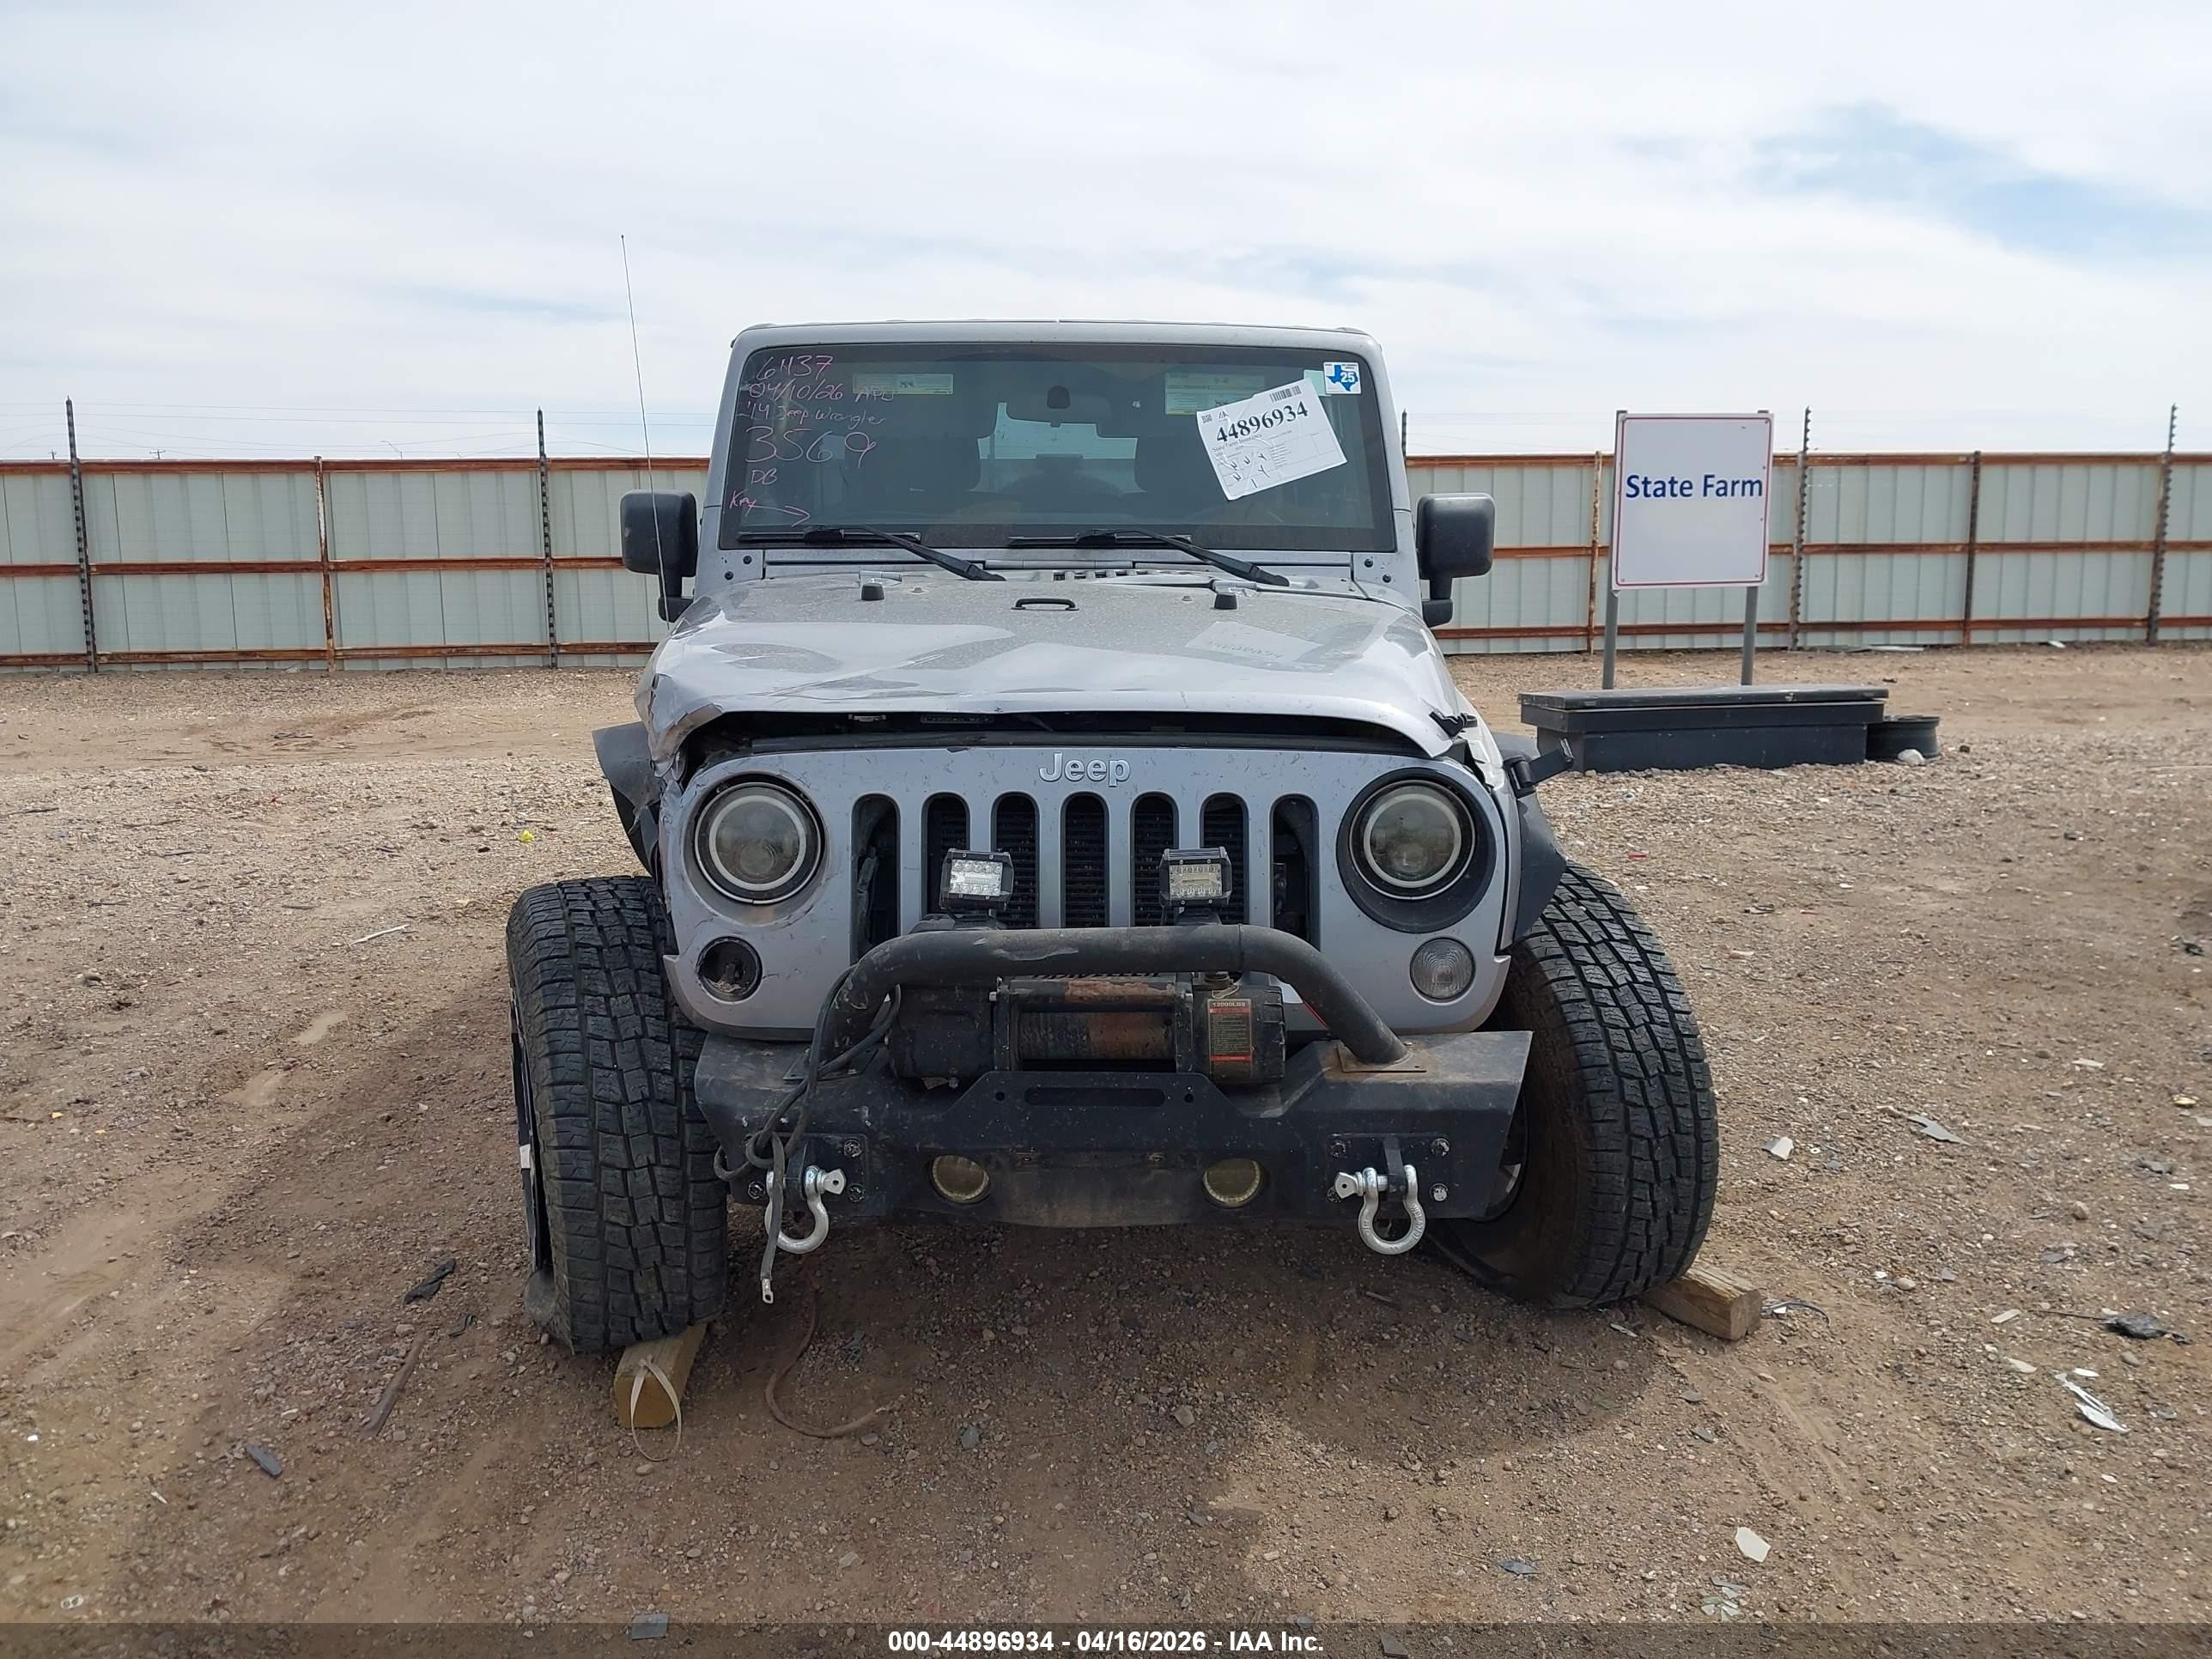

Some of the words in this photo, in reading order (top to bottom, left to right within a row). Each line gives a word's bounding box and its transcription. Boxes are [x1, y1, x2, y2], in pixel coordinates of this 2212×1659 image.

[749, 378, 843, 401] 04/10/26
[1340, 372, 1355, 383] 25
[1217, 401, 1308, 442] 44896934
[744, 426, 877, 468] 3569
[1626, 474, 1693, 498] State
[1703, 474, 1763, 497] Farm
[1039, 752, 1130, 787] Jeep
